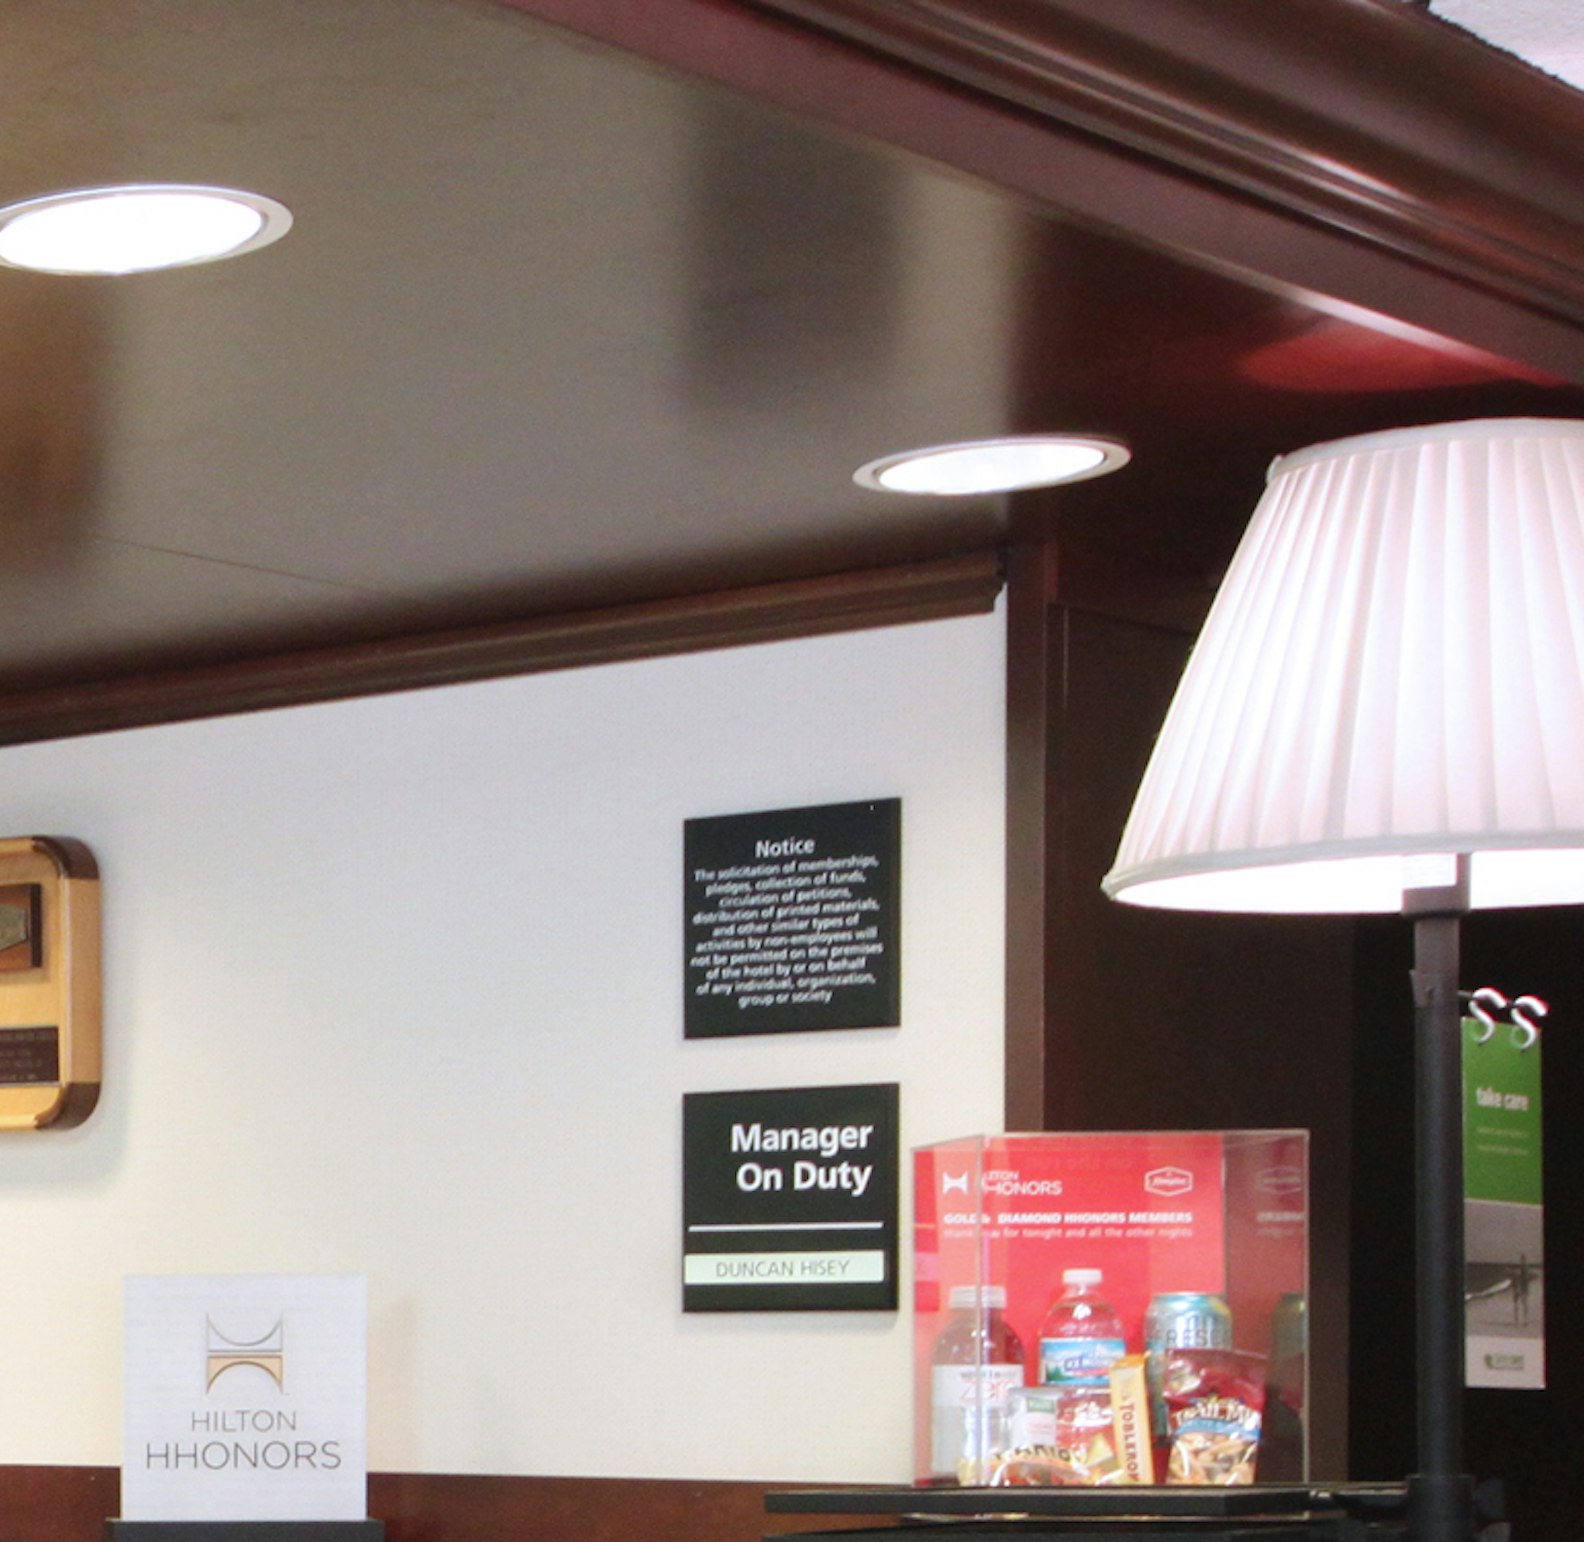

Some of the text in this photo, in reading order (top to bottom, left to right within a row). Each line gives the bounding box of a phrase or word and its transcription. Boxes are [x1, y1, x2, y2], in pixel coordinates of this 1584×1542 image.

[755, 837, 816, 858] Notice
[694, 869, 715, 881] The
[718, 865, 781, 880] solicitation
[782, 861, 797, 874] of
[755, 877, 812, 891] collection
[813, 871, 828, 885] of
[719, 894, 780, 908] circulation
[781, 889, 796, 903] of
[692, 910, 759, 925] distribution
[761, 905, 775, 918] of
[776, 902, 820, 921] printed
[712, 912, 860, 936] and other similar types of
[695, 926, 878, 953] activities by non-employees will
[690, 942, 884, 967] not be permitted on the premises
[705, 956, 866, 980] of the hotel by or on behalf
[695, 982, 710, 995] of
[711, 983, 733, 996] any
[738, 994, 774, 1009] group
[776, 993, 789, 1004] or
[730, 1123, 874, 1157] Manager
[736, 1161, 873, 1197] On Duty
[997, 1211, 1062, 1224] DIAMOND
[1128, 1211, 1193, 1224] MEMBERS
[716, 1259, 851, 1278] DUNCAN HISEY
[191, 1410, 297, 1432] HILTON
[146, 1441, 342, 1469] HHONORS
